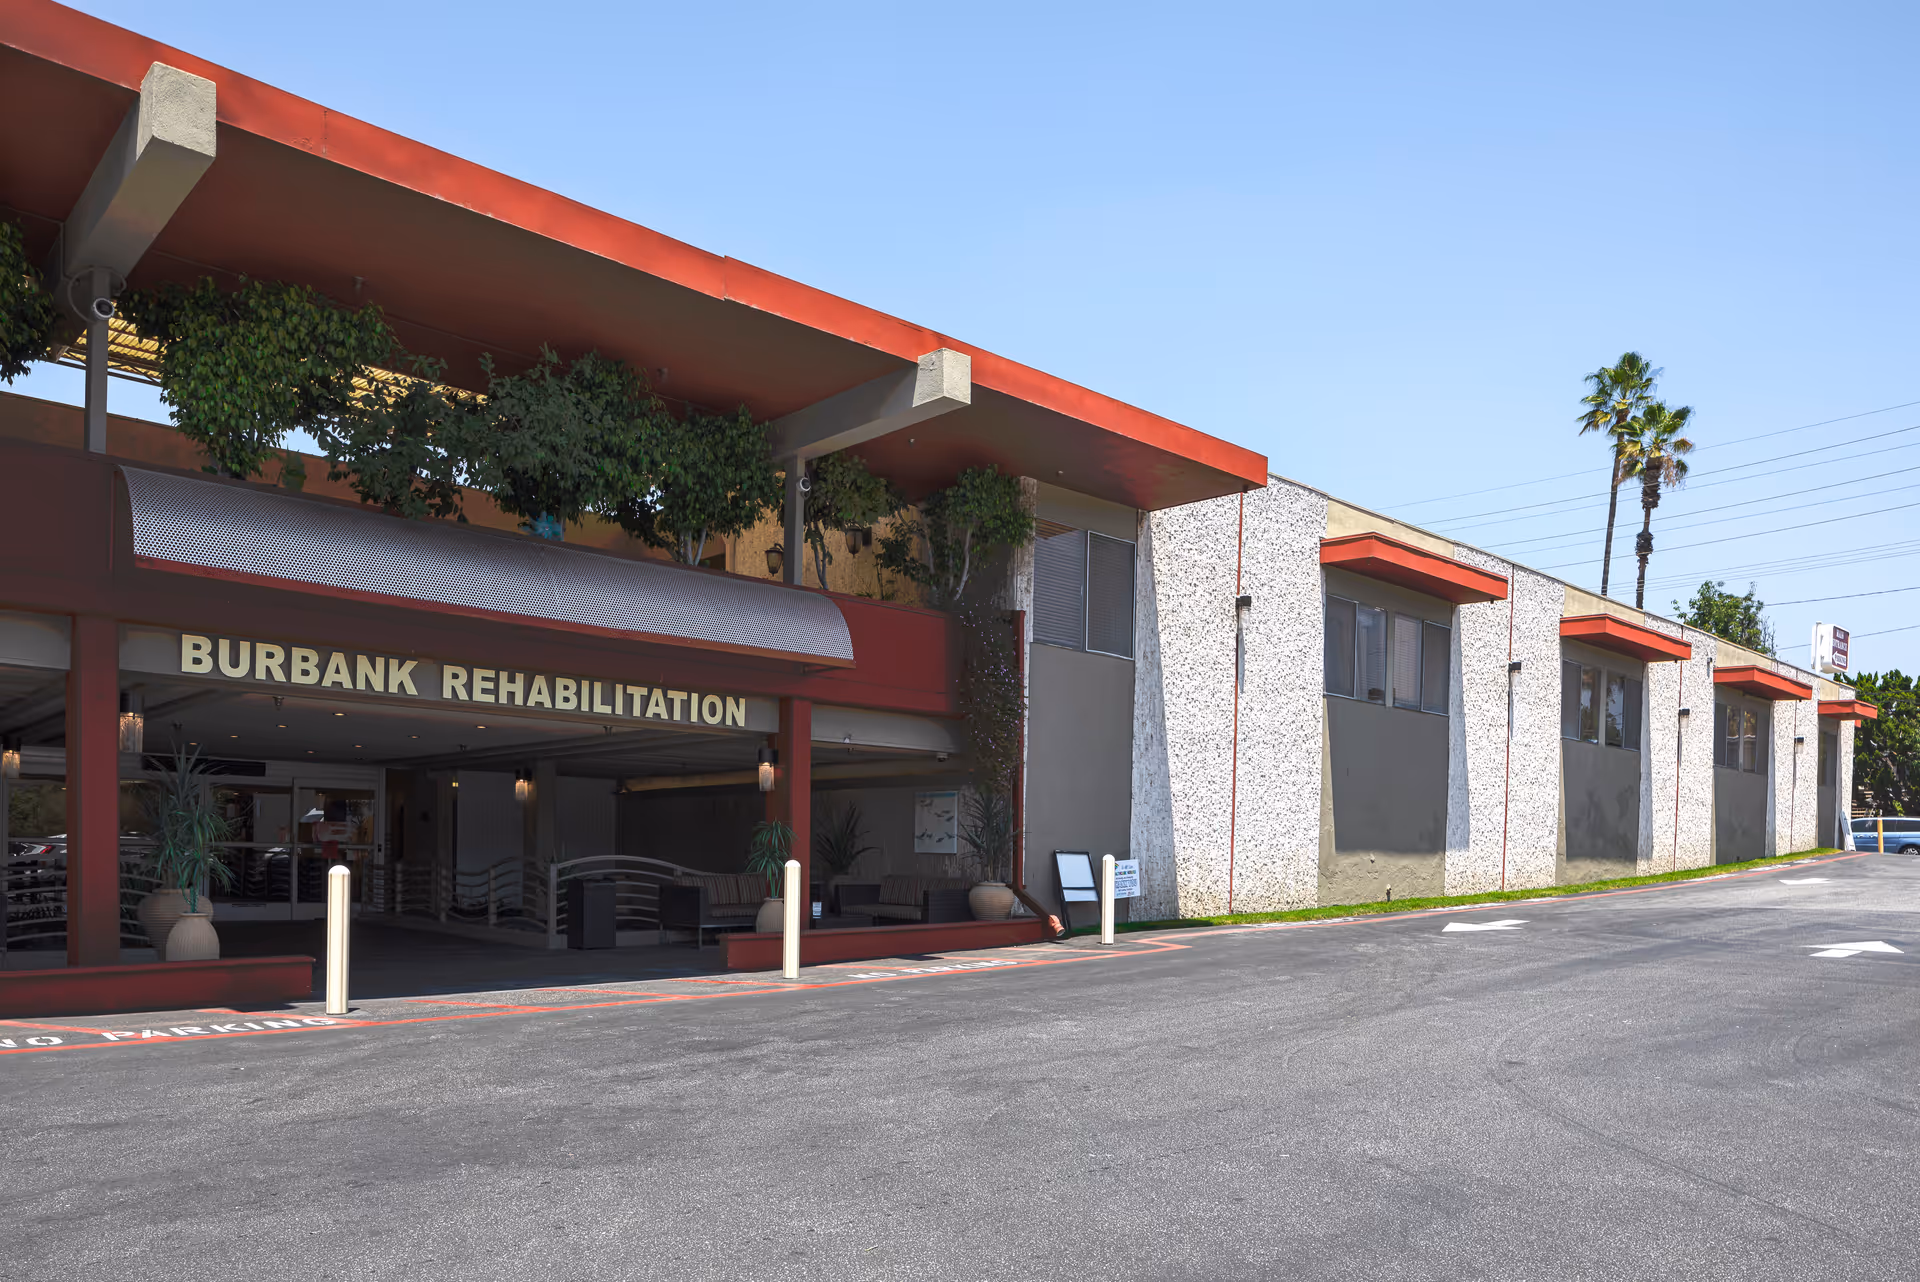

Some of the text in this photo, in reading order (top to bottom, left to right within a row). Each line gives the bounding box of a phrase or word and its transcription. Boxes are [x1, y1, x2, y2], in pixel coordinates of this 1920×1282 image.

[181, 633, 746, 727] BURBANK REHABILITATION
[900, 960, 1018, 974] PARKING
[101, 1017, 336, 1041] PARKING
